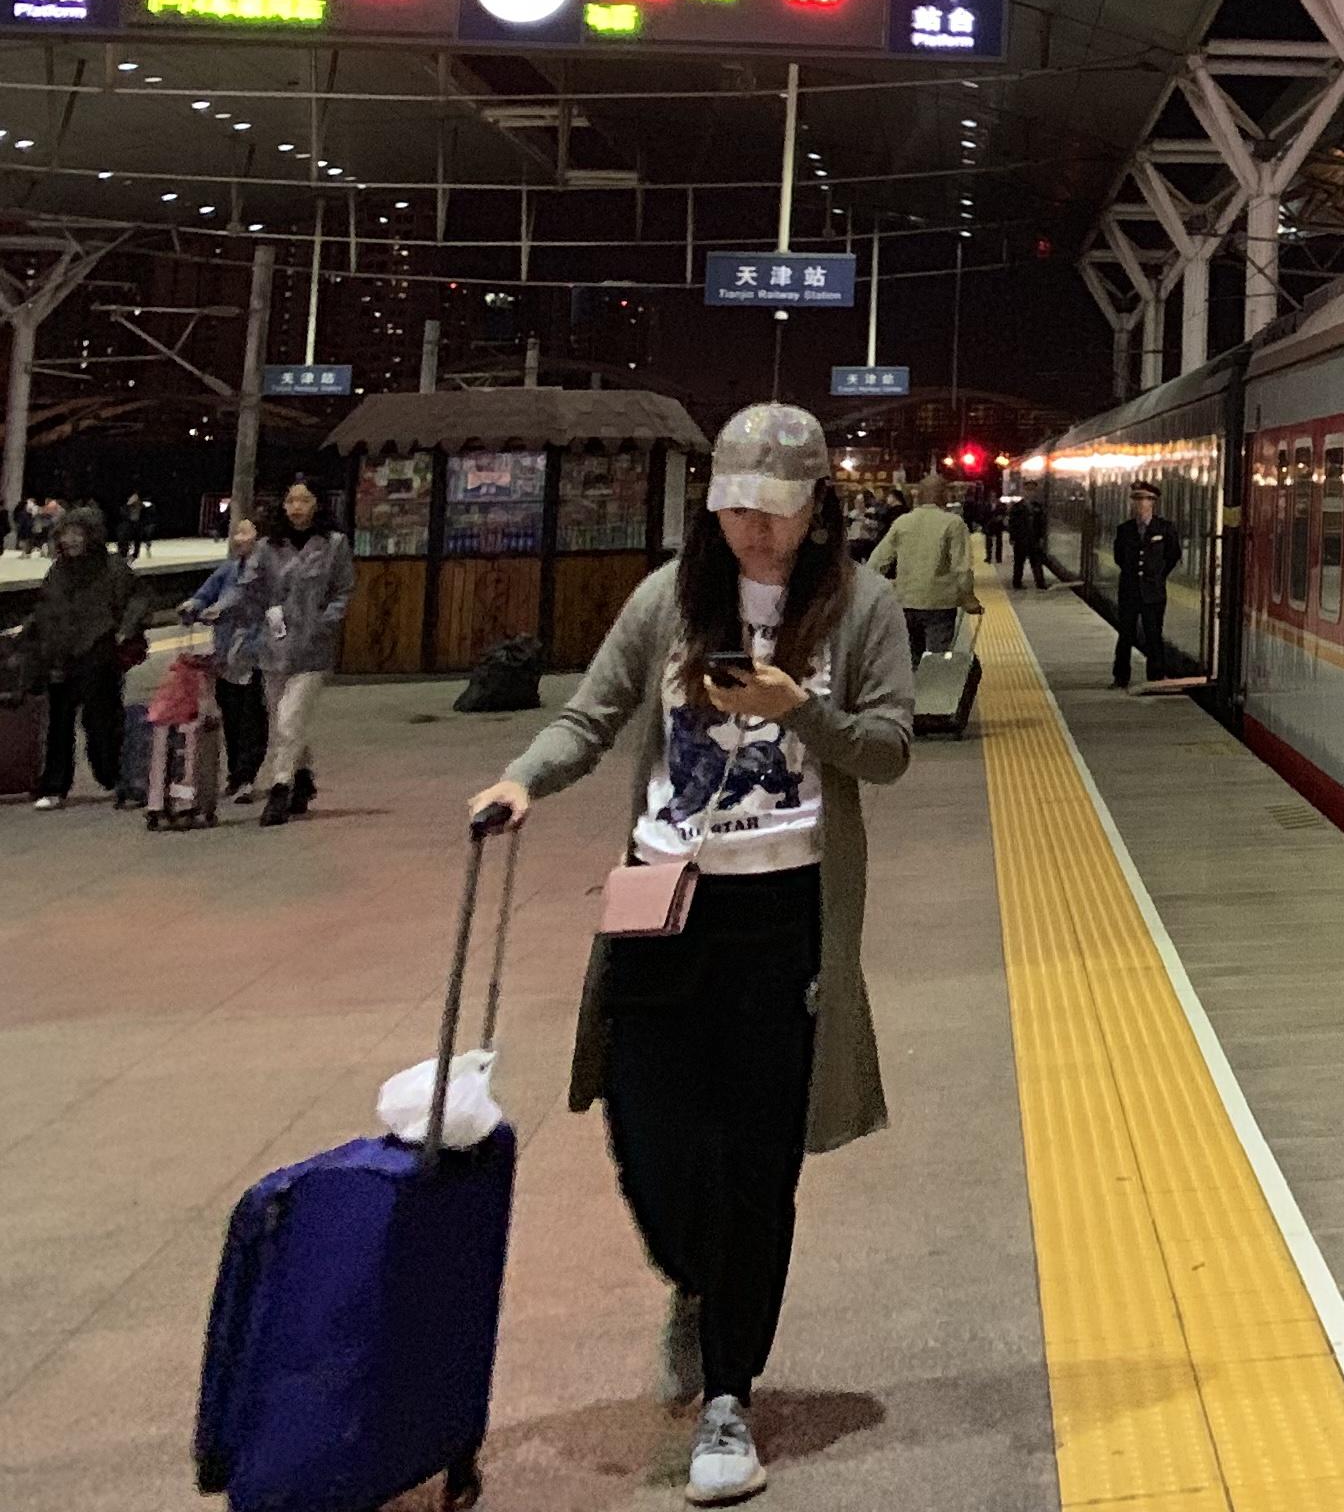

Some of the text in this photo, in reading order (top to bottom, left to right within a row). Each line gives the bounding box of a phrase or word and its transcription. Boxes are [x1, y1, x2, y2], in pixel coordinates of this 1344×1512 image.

[911, 5, 975, 33] 站台
[734, 264, 828, 287] 天津站
[758, 289, 800, 302] Railway
